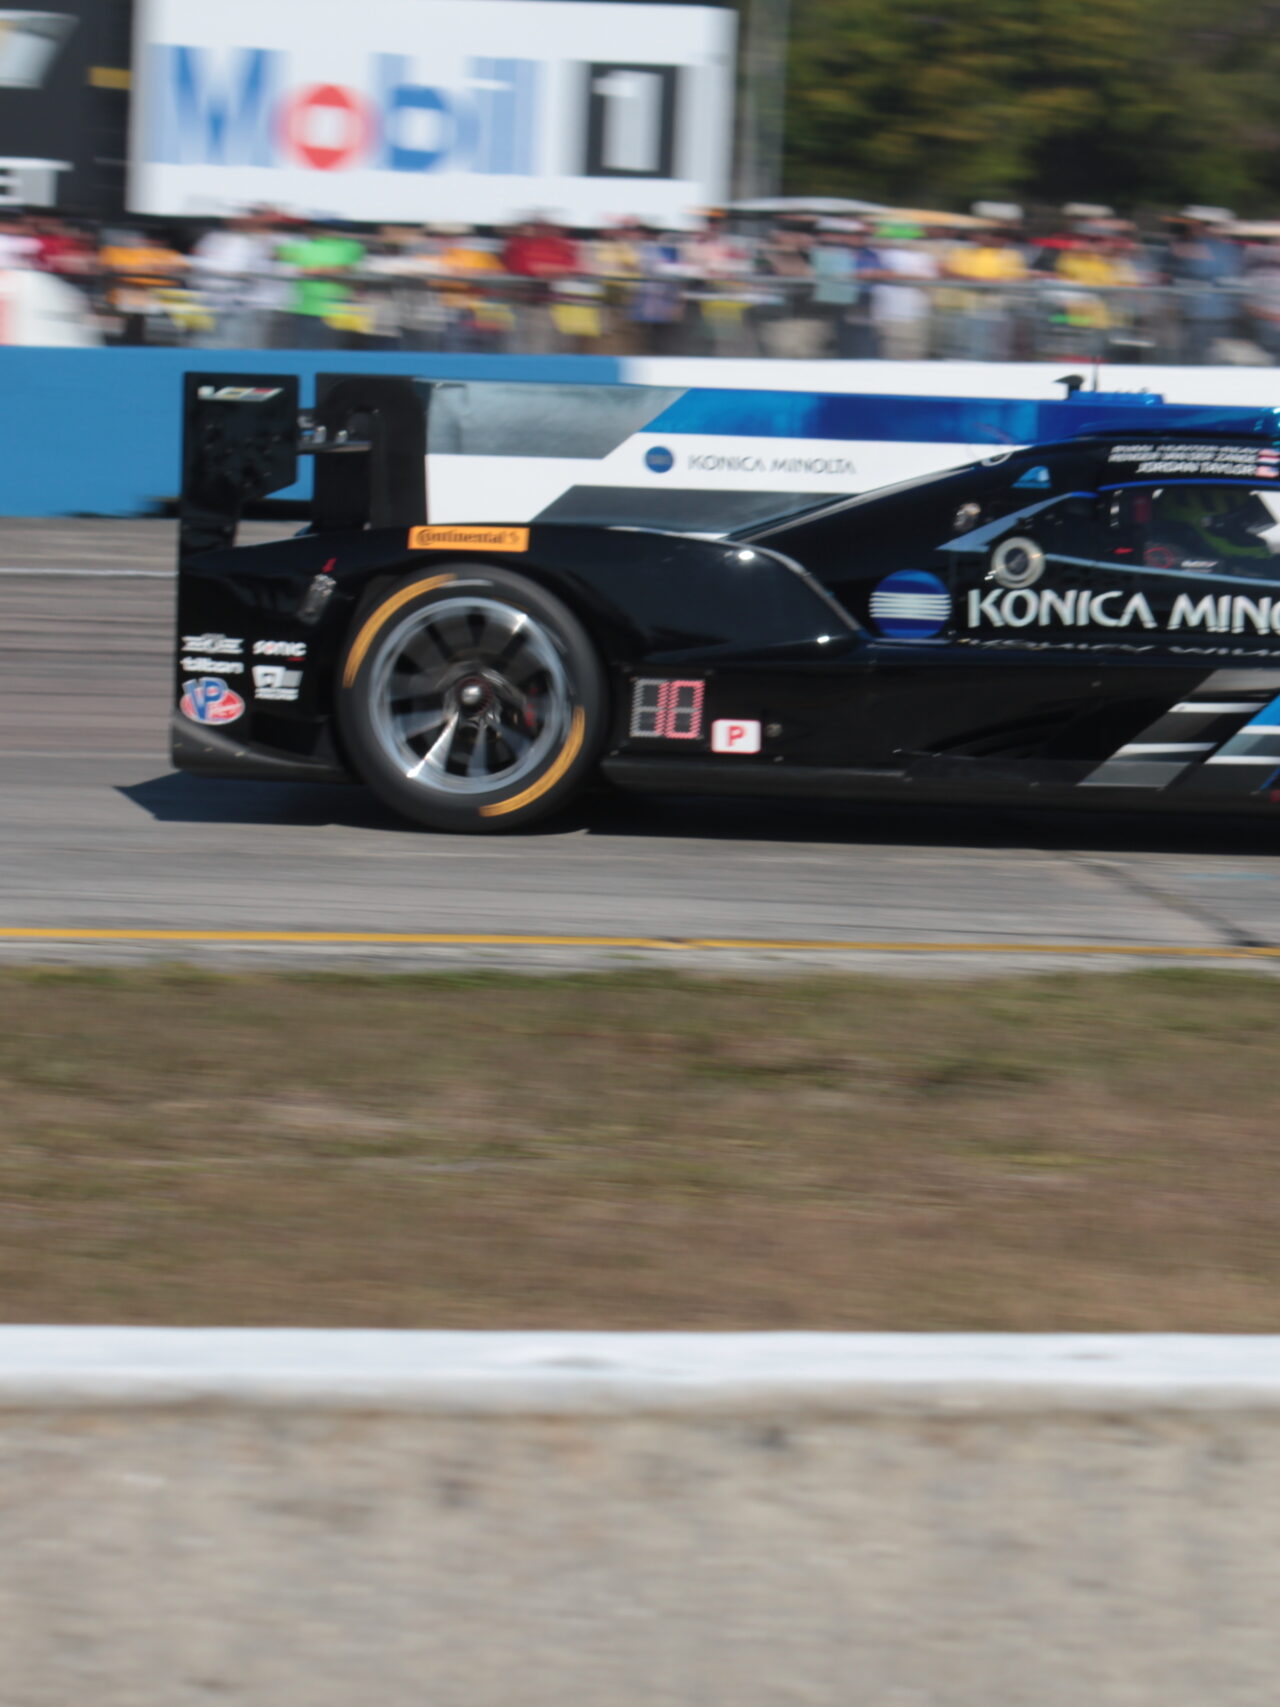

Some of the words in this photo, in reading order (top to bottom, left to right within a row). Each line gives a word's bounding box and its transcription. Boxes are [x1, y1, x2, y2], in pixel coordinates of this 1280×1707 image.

[145, 43, 538, 174] Mobil
[688, 455, 767, 472] KONICA
[769, 458, 857, 475] MINOLTA
[967, 588, 1158, 629] KONICA
[182, 677, 229, 721] VP
[727, 724, 747, 747] P
